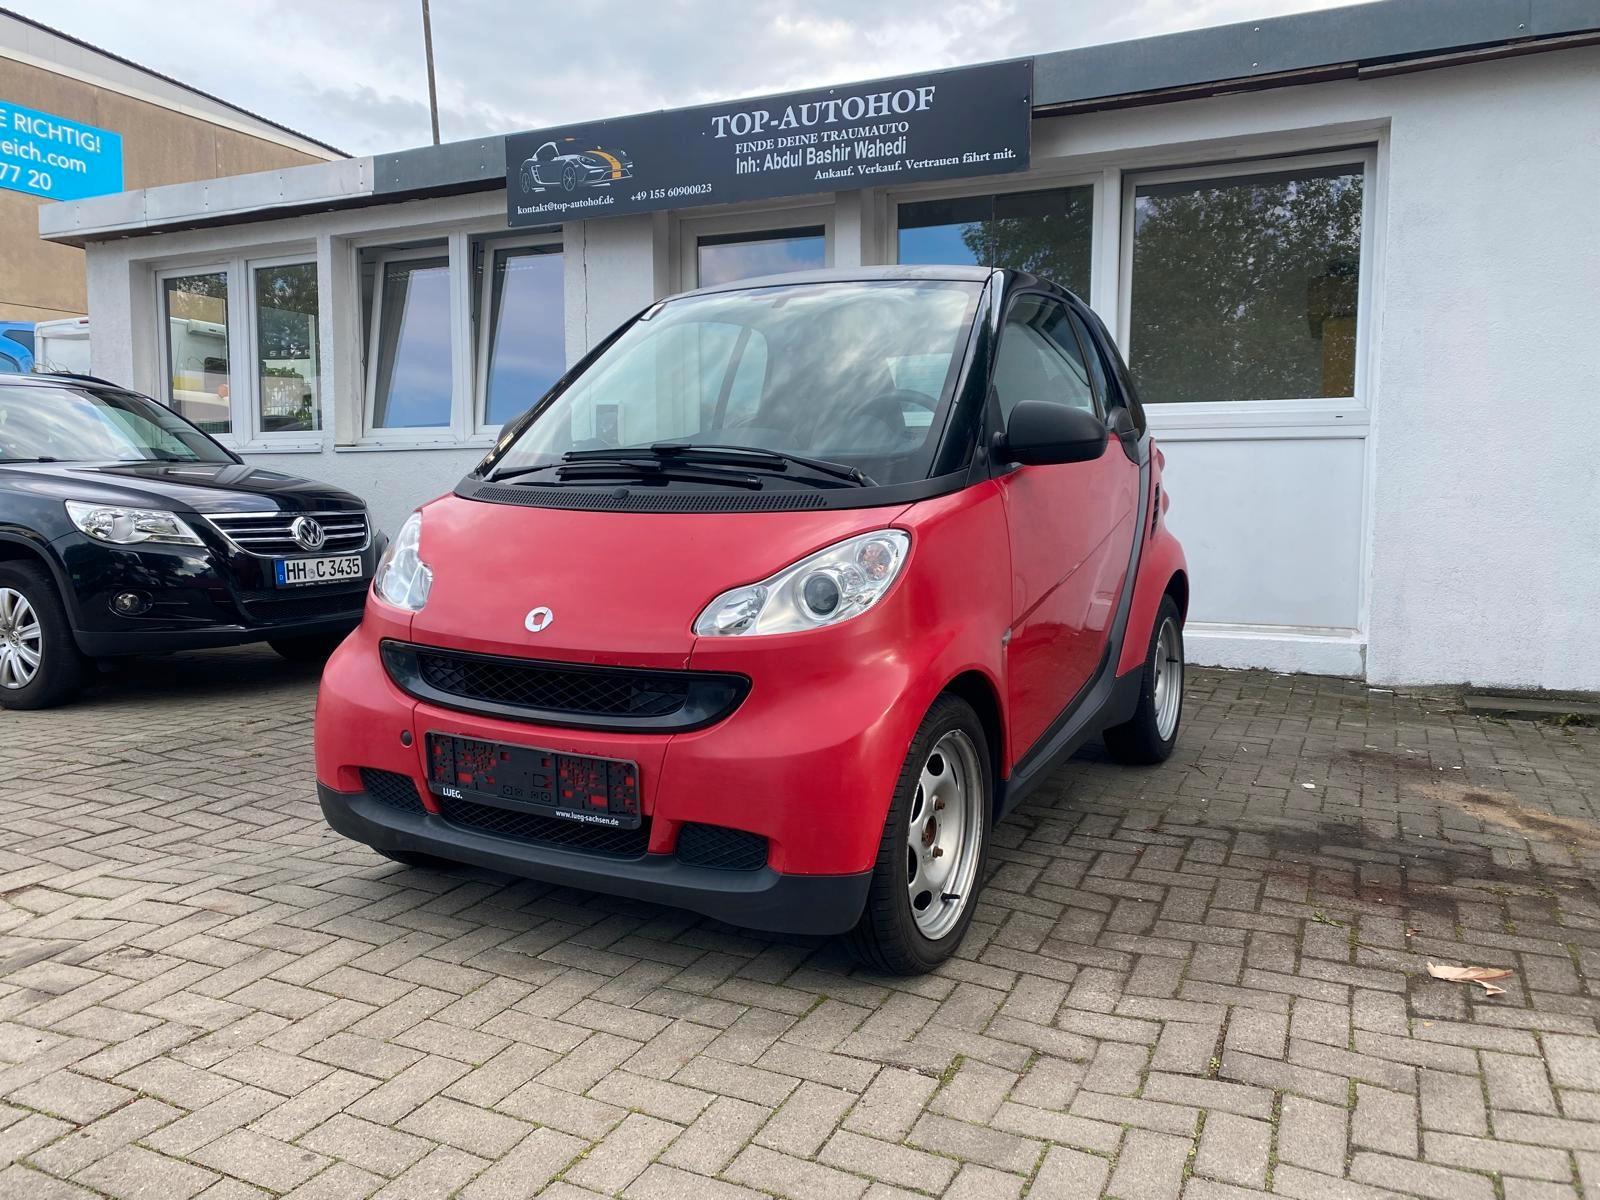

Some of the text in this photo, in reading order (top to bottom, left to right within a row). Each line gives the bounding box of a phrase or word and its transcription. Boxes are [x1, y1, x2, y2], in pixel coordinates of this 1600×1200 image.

[711, 86, 936, 139] TOP-AUTOHOF
[14, 112, 102, 153] RICHTIG!
[735, 121, 909, 154] FINDE DEINE TRAUMAUTO
[736, 135, 907, 174] Inh: Abdul Bashir Wahedi
[814, 147, 1017, 180] Ankauf. Verkauf. Vertrauen fährt mit.
[28, 169, 52, 190] 20
[630, 183, 712, 201] +49 155 60900023
[517, 195, 615, 215] kontakt@top-autohof.de
[286, 558, 361, 581] HH C 3435
[555, 810, 620, 826] www.lueg-sachsen.de
